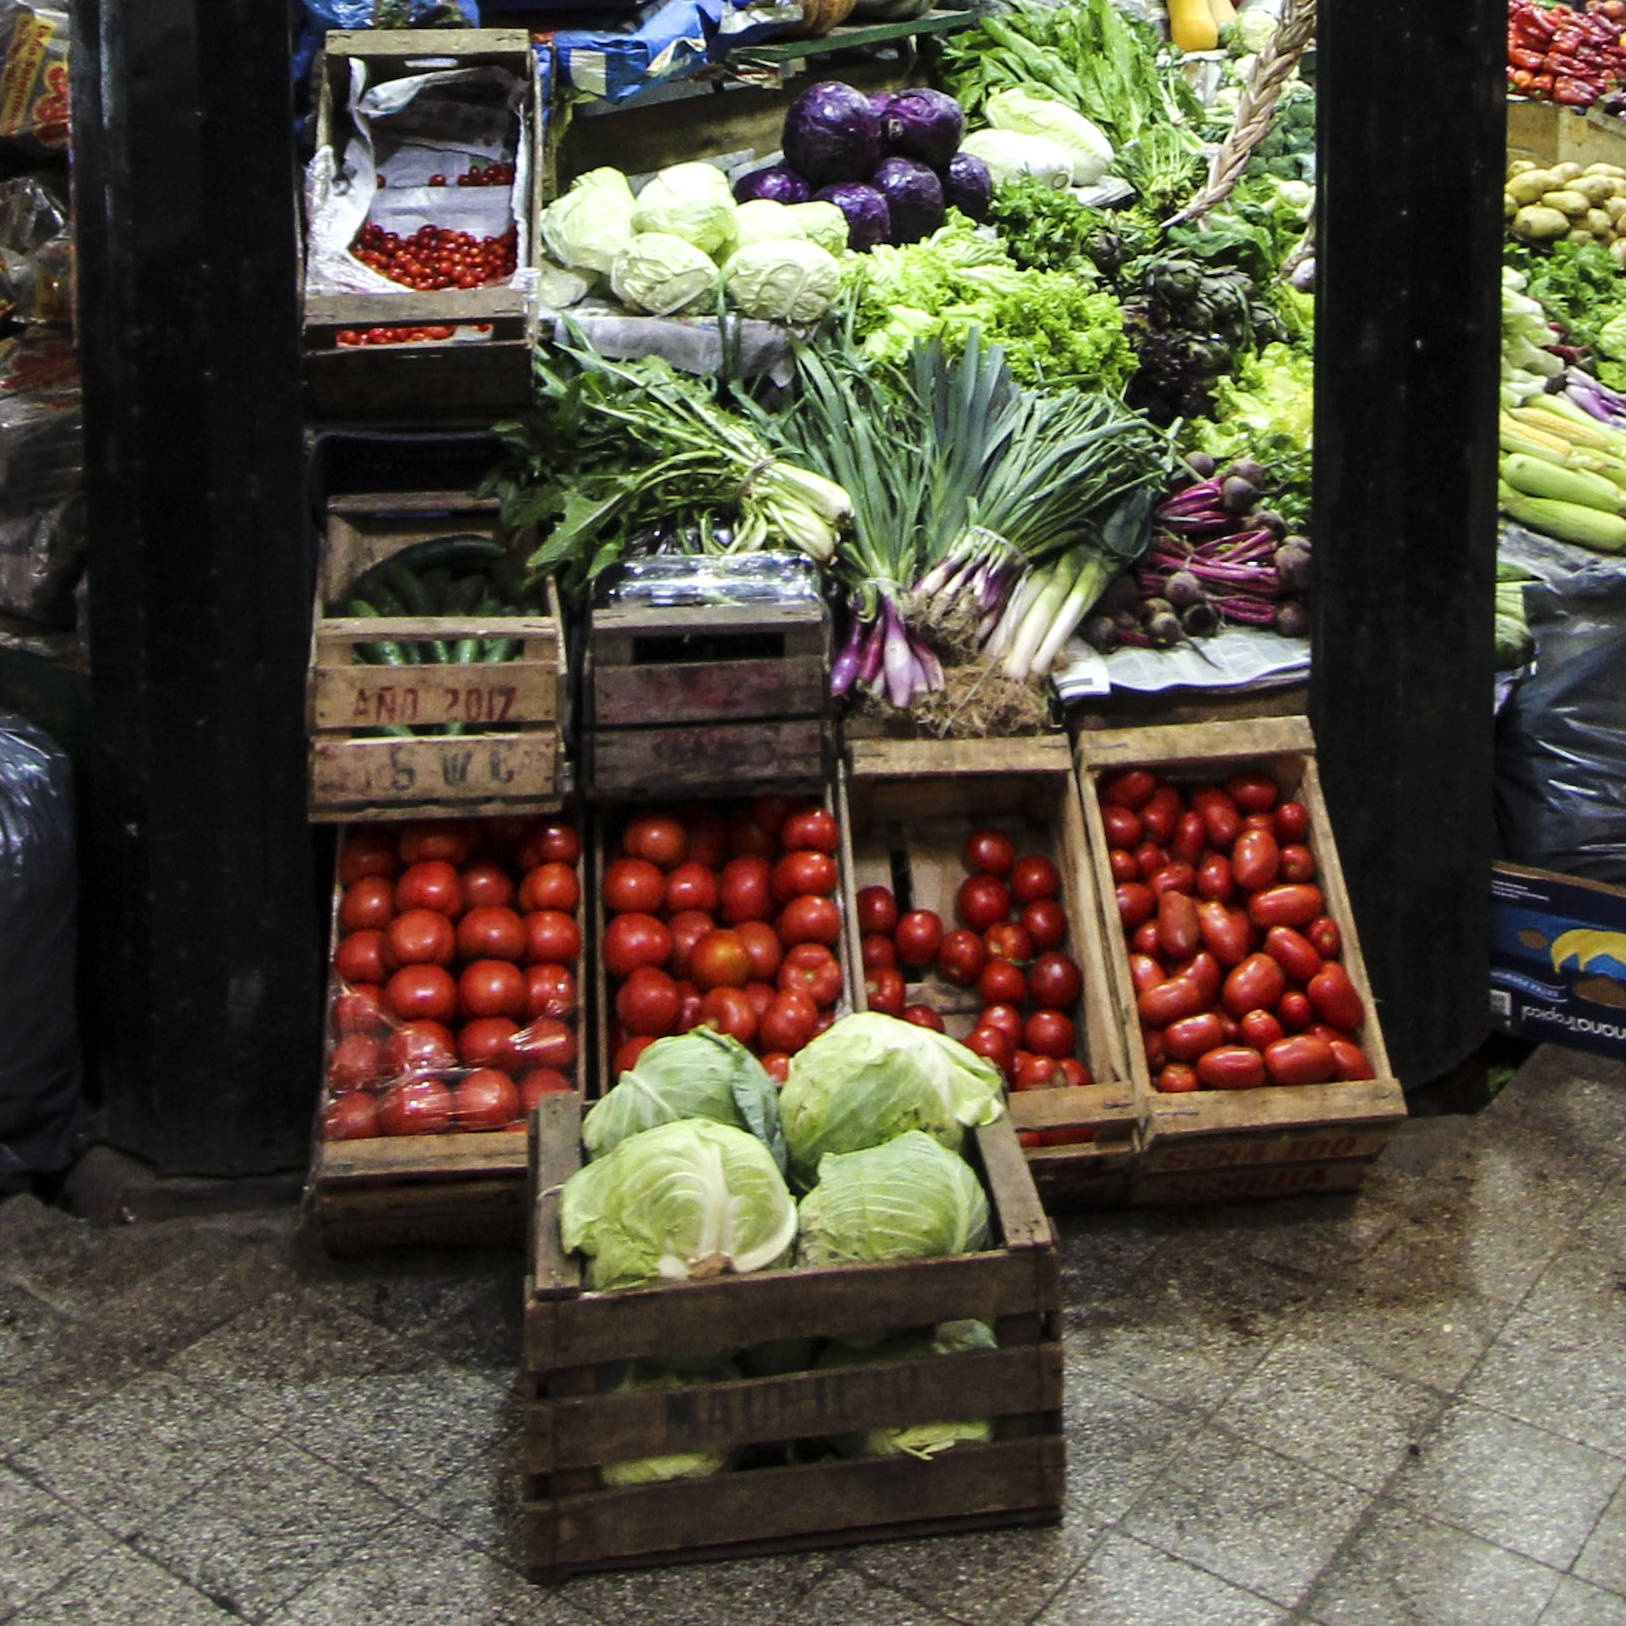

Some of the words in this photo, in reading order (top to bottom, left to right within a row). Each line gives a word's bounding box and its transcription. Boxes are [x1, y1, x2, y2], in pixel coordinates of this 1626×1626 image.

[352, 686, 420, 721] AÑO
[445, 686, 518, 724] 2017
[1290, 1136, 1358, 1159] 100
